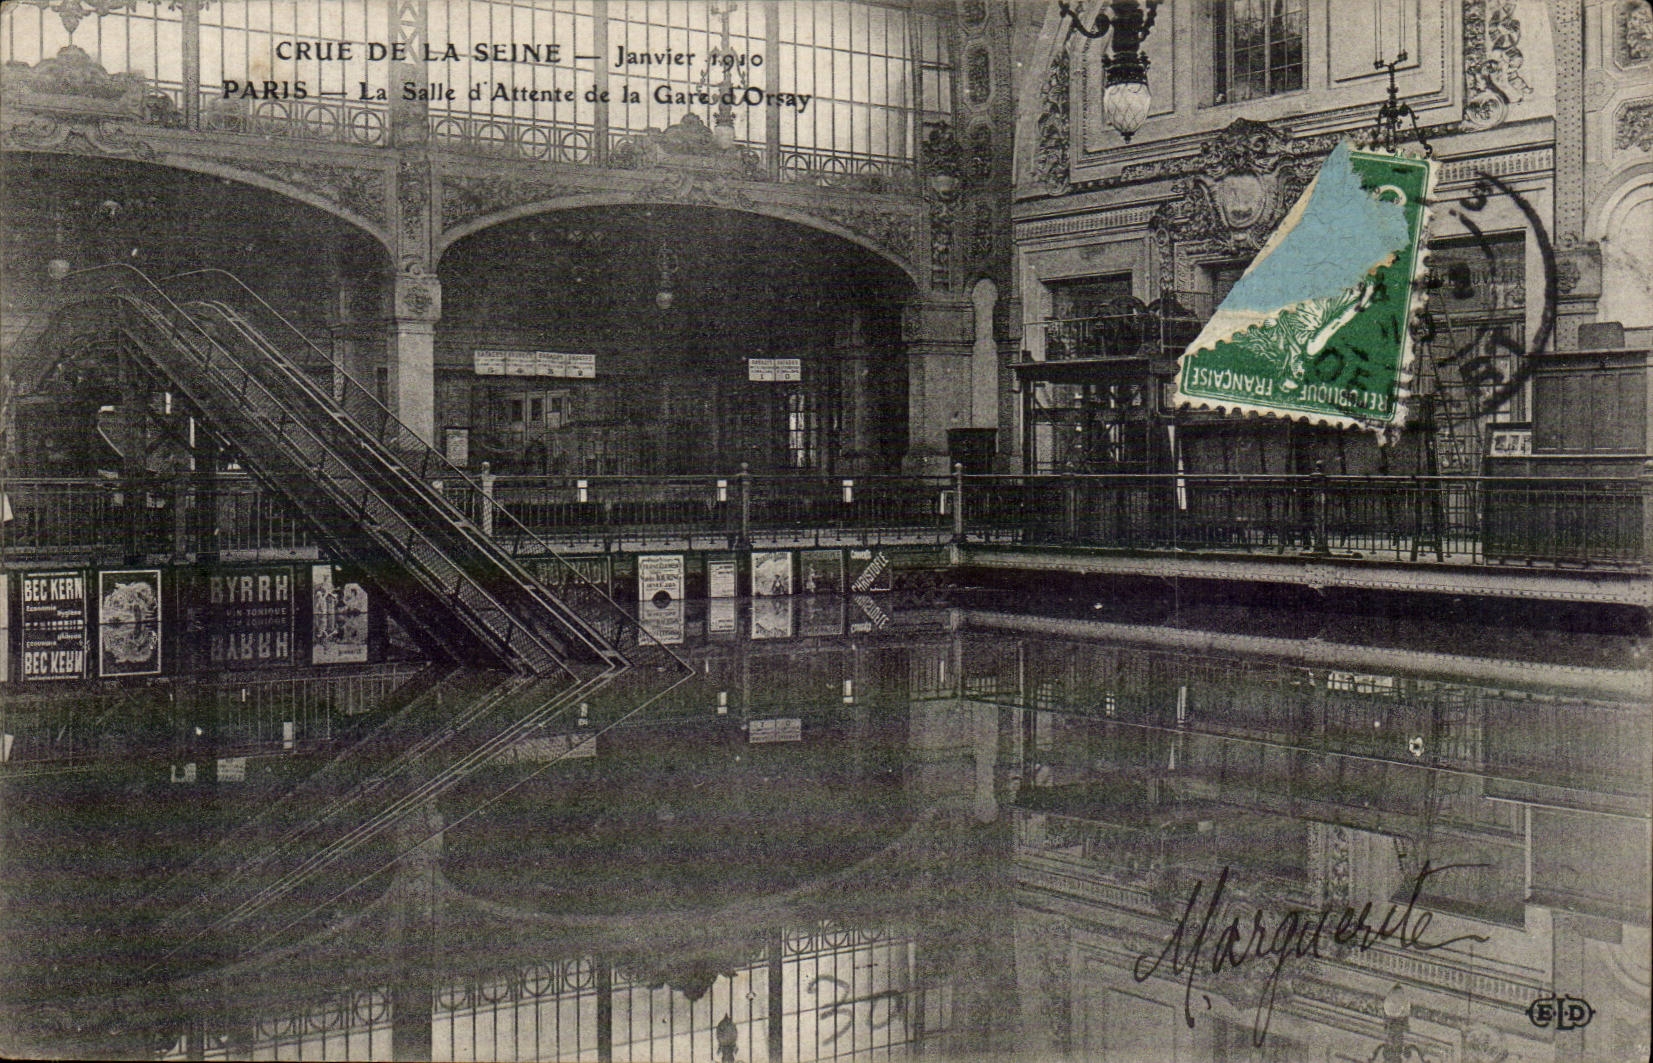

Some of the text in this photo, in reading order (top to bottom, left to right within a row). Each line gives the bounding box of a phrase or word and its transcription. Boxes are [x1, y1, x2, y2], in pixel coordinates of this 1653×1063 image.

[1192, 367, 1273, 396] FRANÇAISE
[24, 577, 83, 602] BEC KERN
[210, 575, 288, 604] BYRRH
[226, 607, 287, 617] VIN TONIQUE
